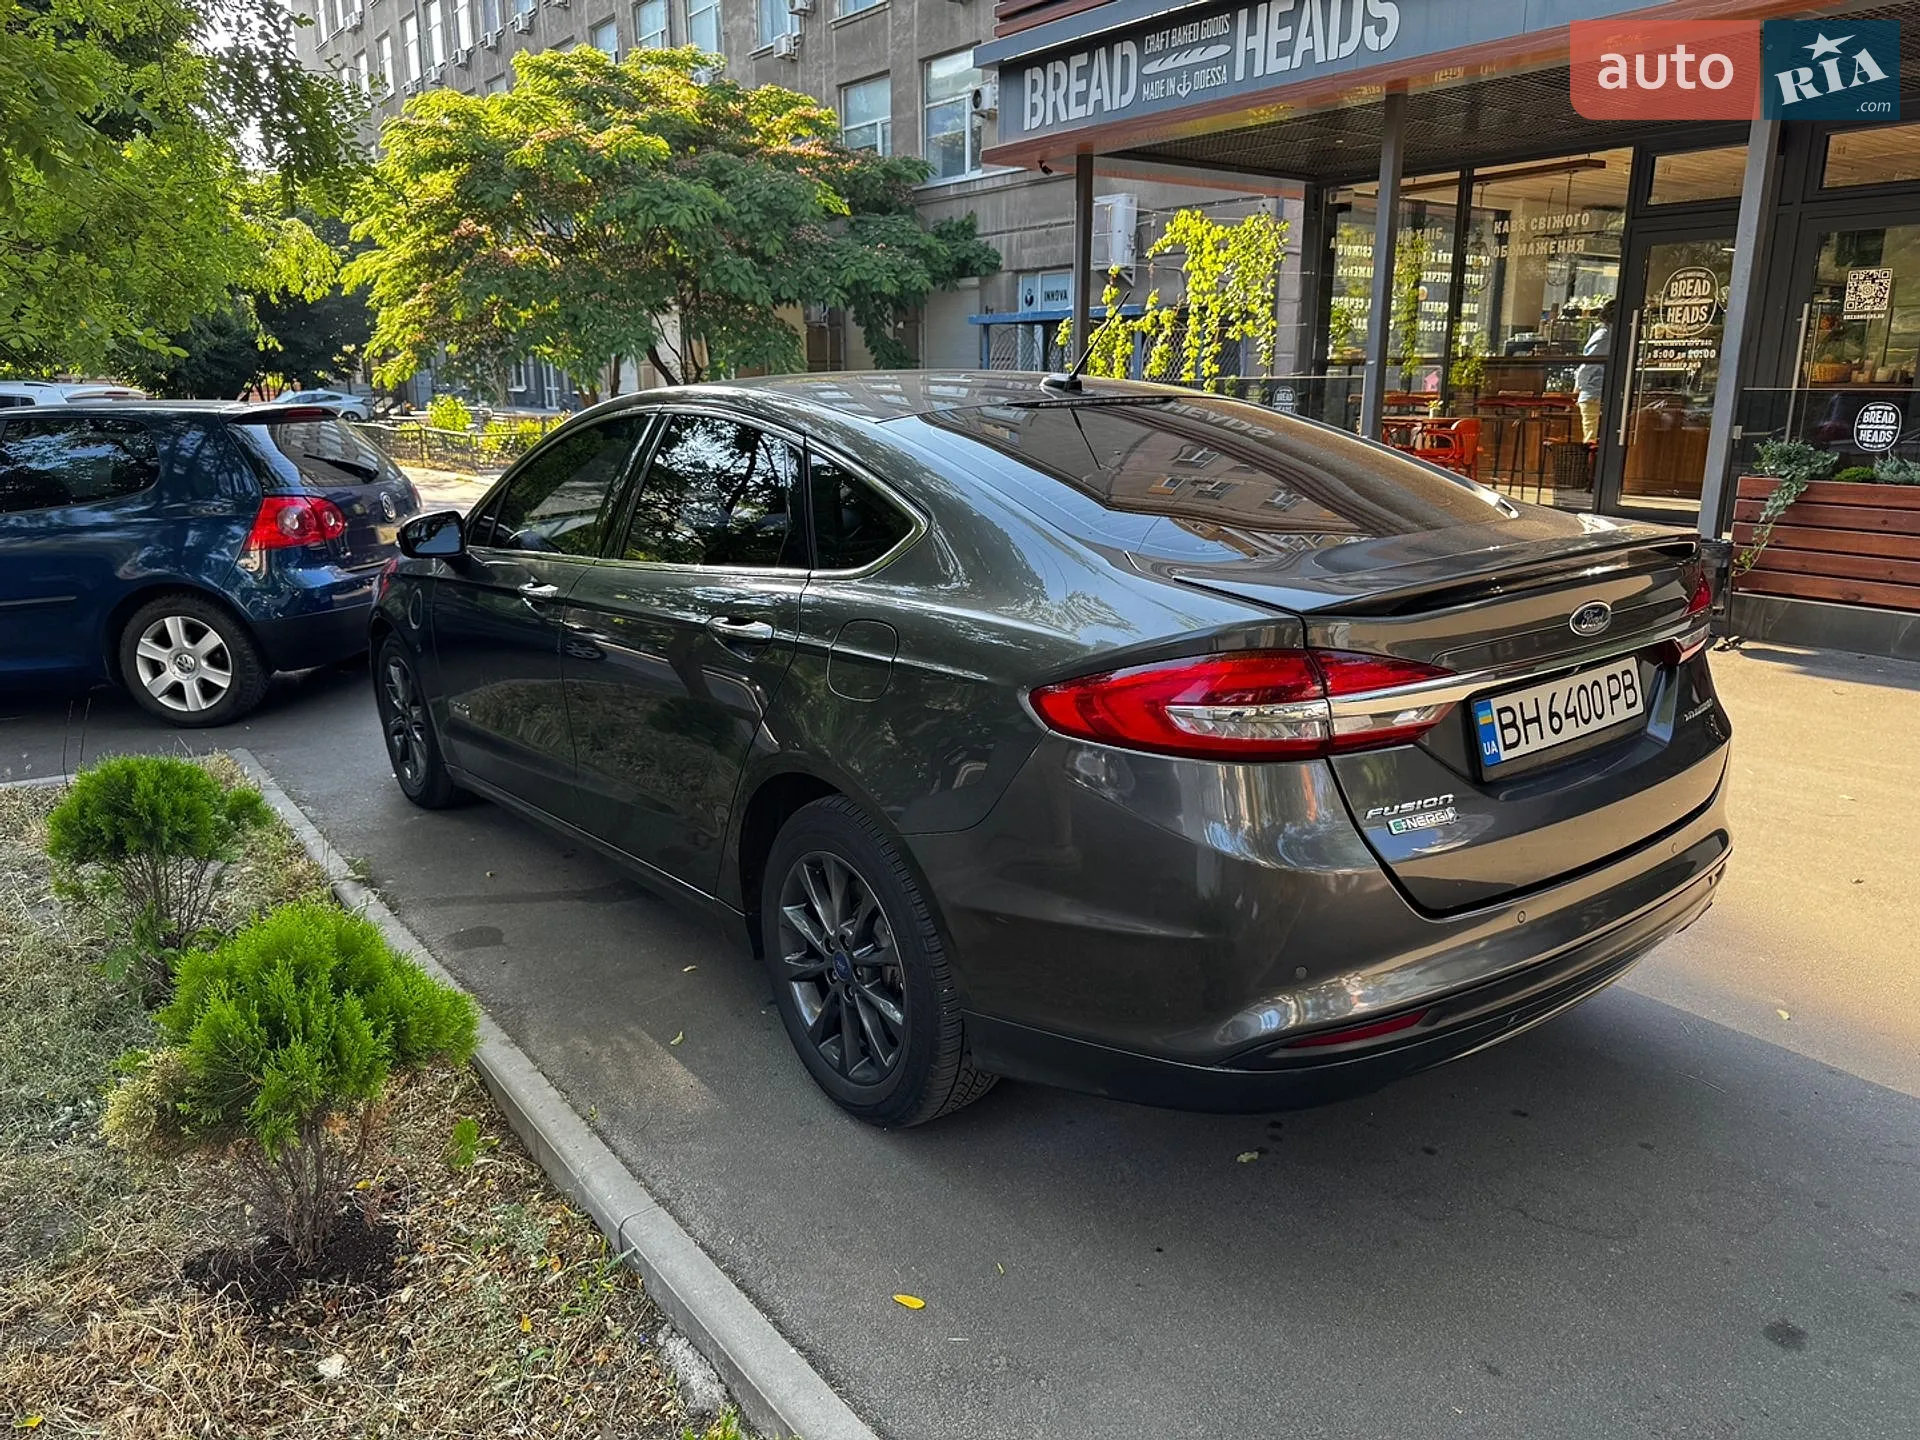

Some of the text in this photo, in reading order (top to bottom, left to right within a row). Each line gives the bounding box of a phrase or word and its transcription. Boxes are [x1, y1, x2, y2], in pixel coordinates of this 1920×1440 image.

[1144, 13, 1231, 55] CRAFT BAKED GOODS
[1023, 0, 1400, 131] BREAD HEADS
[1142, 64, 1228, 102] MADE IN ODESSA
[1530, 212, 1590, 231] СВІЖОГО
[1669, 279, 1712, 298] BREAD
[1666, 305, 1708, 324] HEADS
[1862, 410, 1896, 424] BREAD
[1859, 429, 1894, 443] HEADS
[1496, 698, 1544, 751] BH
[1548, 680, 1605, 735] 6400
[1606, 669, 1638, 715] PB
[1482, 741, 1498, 755] UA
[1365, 793, 1455, 820] FUSION
